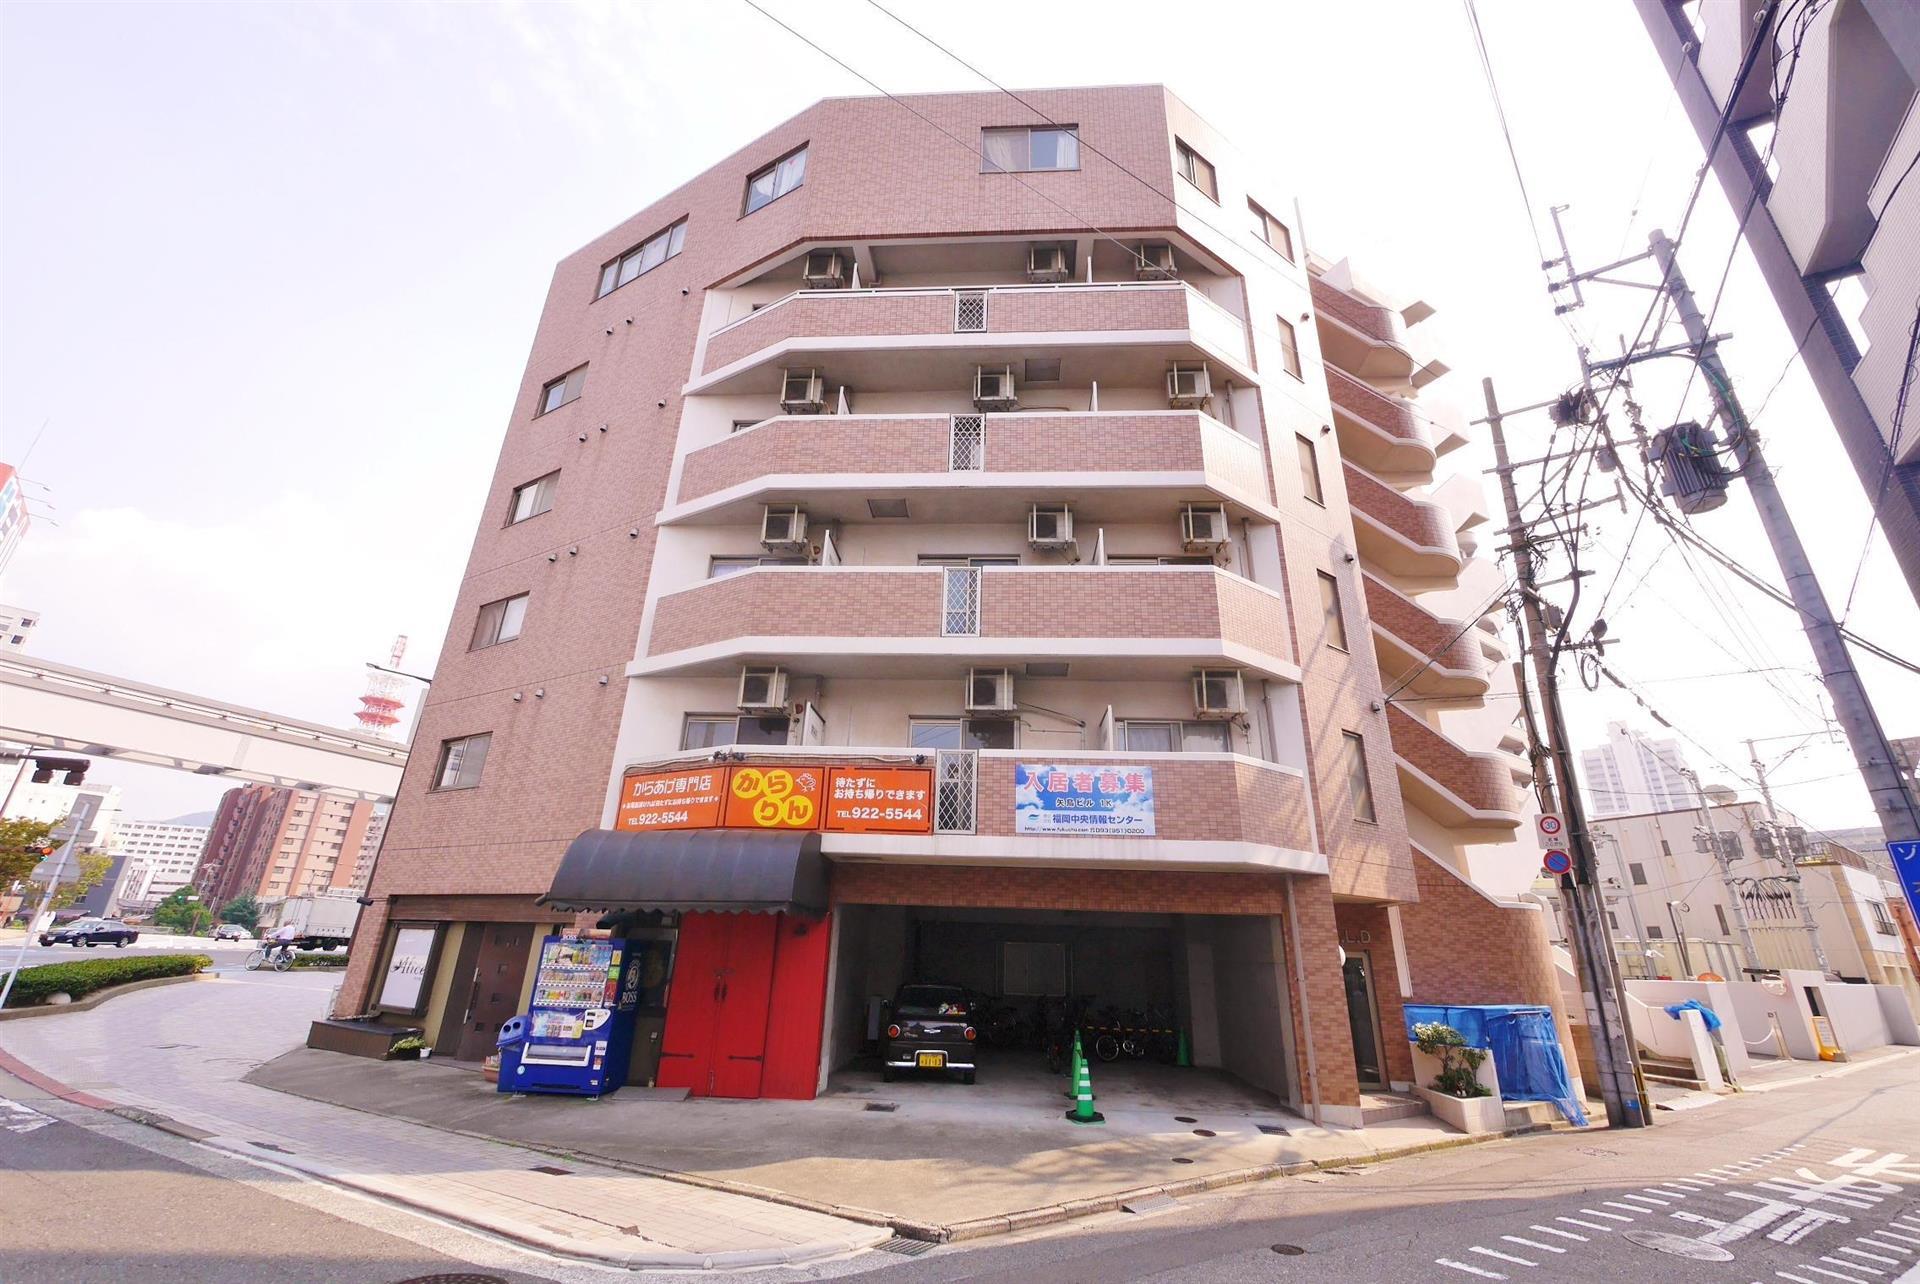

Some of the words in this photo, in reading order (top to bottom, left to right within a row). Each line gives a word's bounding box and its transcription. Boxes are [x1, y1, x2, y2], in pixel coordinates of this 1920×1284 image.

[633, 774, 713, 797] からあげ専門店
[835, 777, 875, 788] 待たずに
[1023, 771, 1145, 794] 入居者募集
[834, 789, 925, 800] お持ち帰りできます
[638, 811, 688, 825] 922-5544
[852, 806, 922, 820] 922-5544
[1053, 813, 1143, 825] 福岡中央情報センター
[1545, 821, 1556, 830] 30
[622, 990, 638, 1004] BOSS
